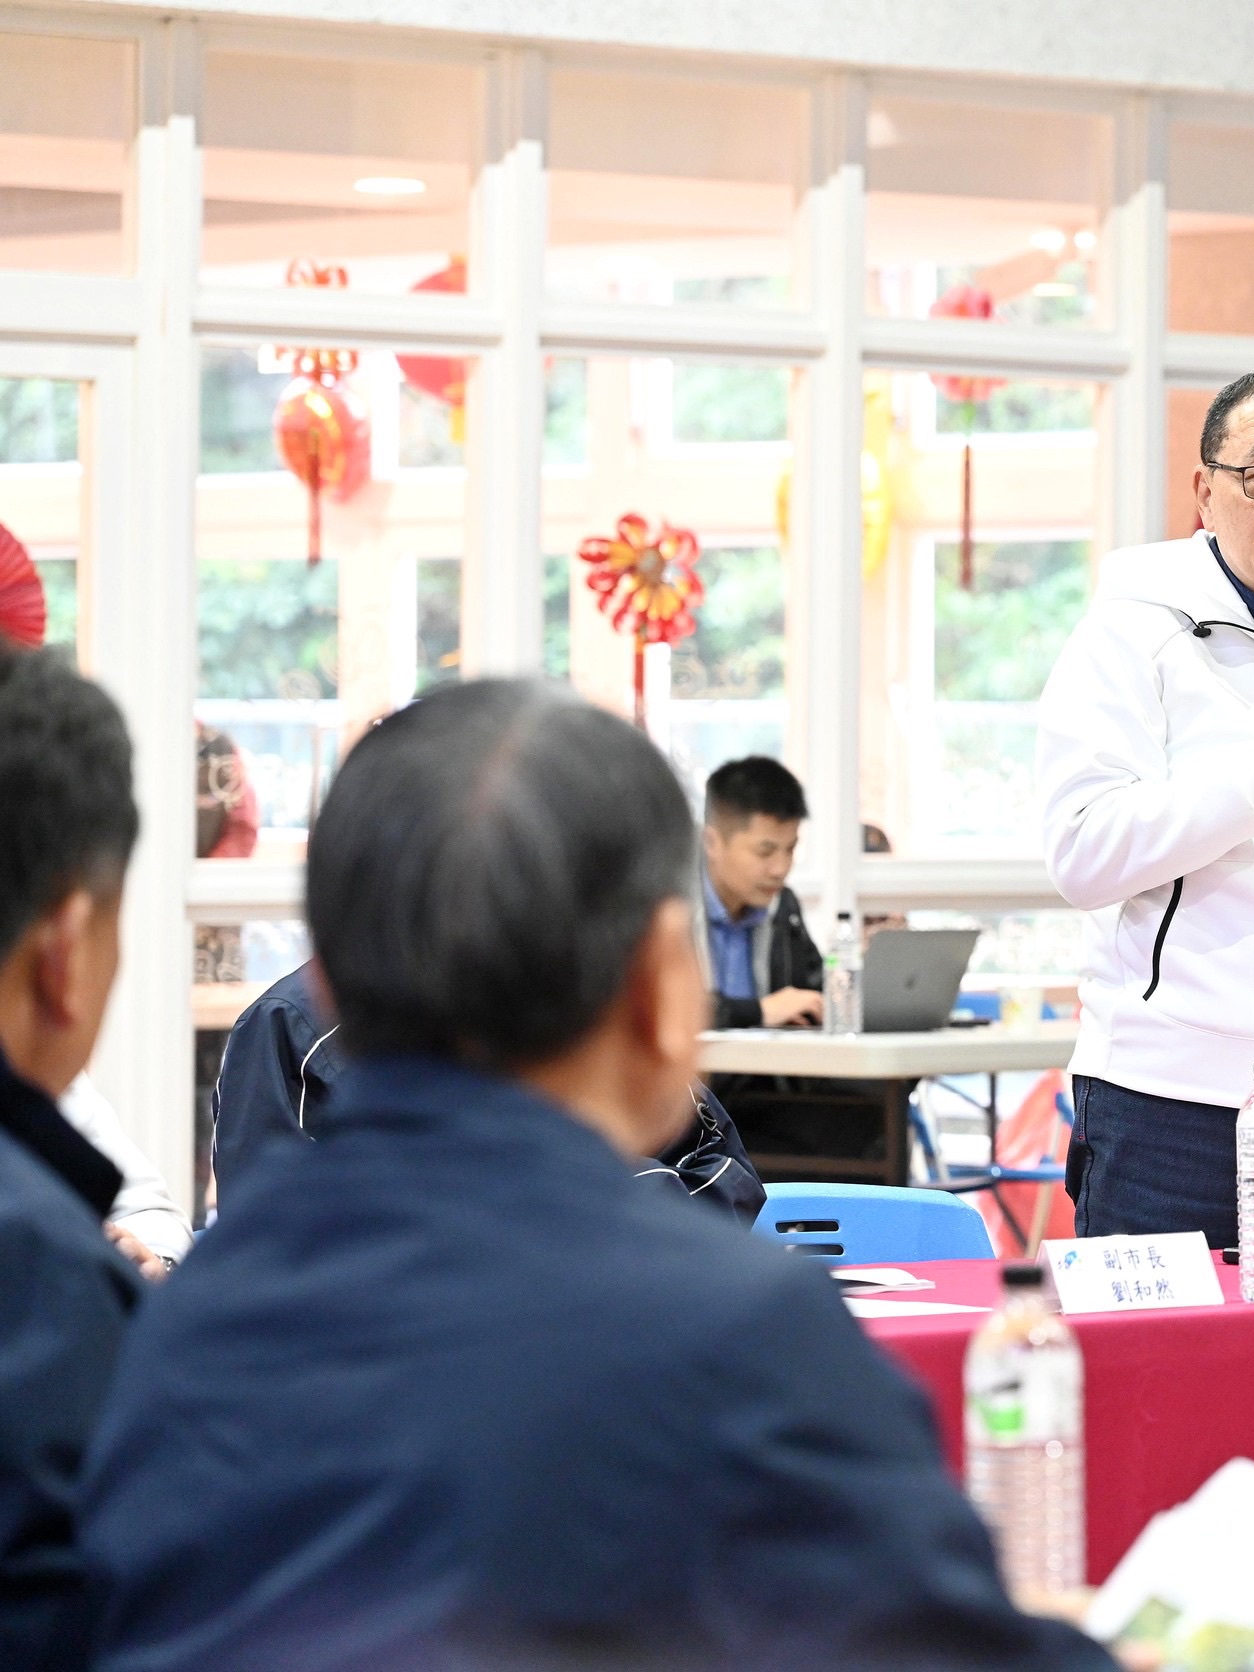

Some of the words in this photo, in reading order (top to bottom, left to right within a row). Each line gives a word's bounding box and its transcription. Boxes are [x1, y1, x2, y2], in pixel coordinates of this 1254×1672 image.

[1102, 1246, 1167, 1271] 副市長
[1111, 1278, 1175, 1303] 劉和然
